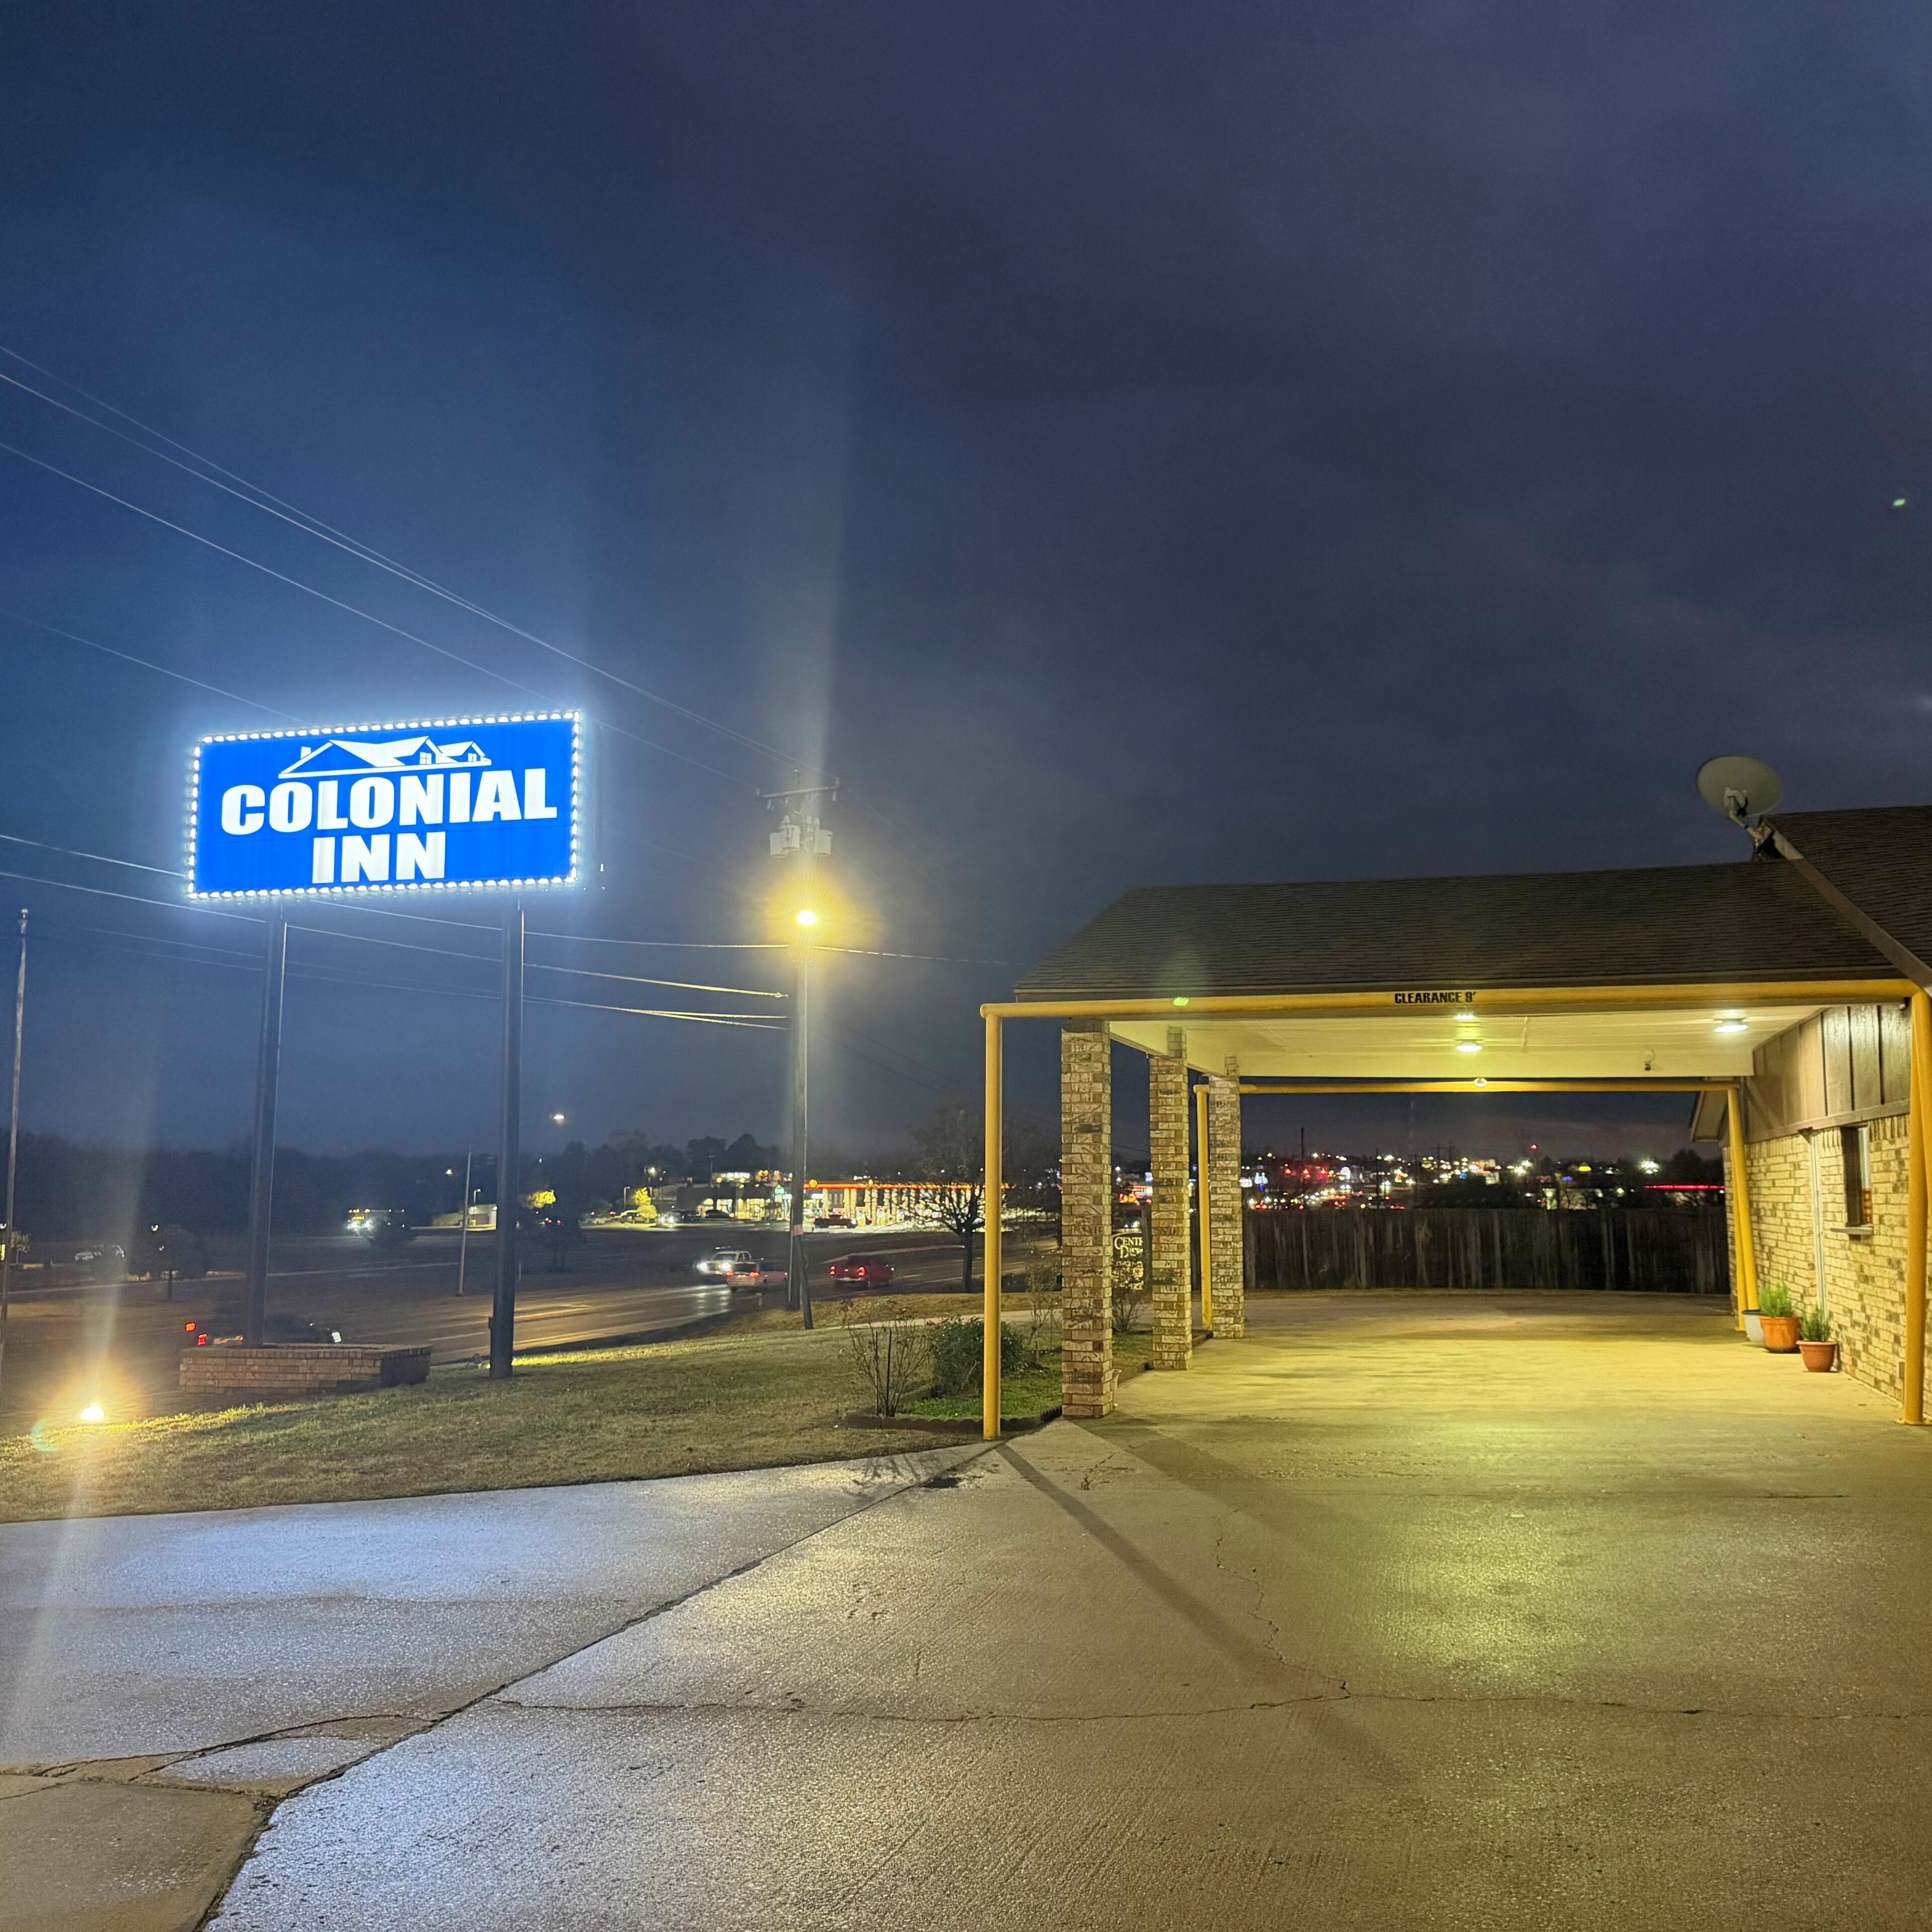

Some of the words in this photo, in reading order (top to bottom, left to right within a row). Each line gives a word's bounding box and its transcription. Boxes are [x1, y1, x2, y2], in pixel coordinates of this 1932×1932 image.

[221, 768, 557, 835] COLONIAL
[312, 831, 446, 884] INN
[1394, 992, 1462, 1004] CLEARANCE
